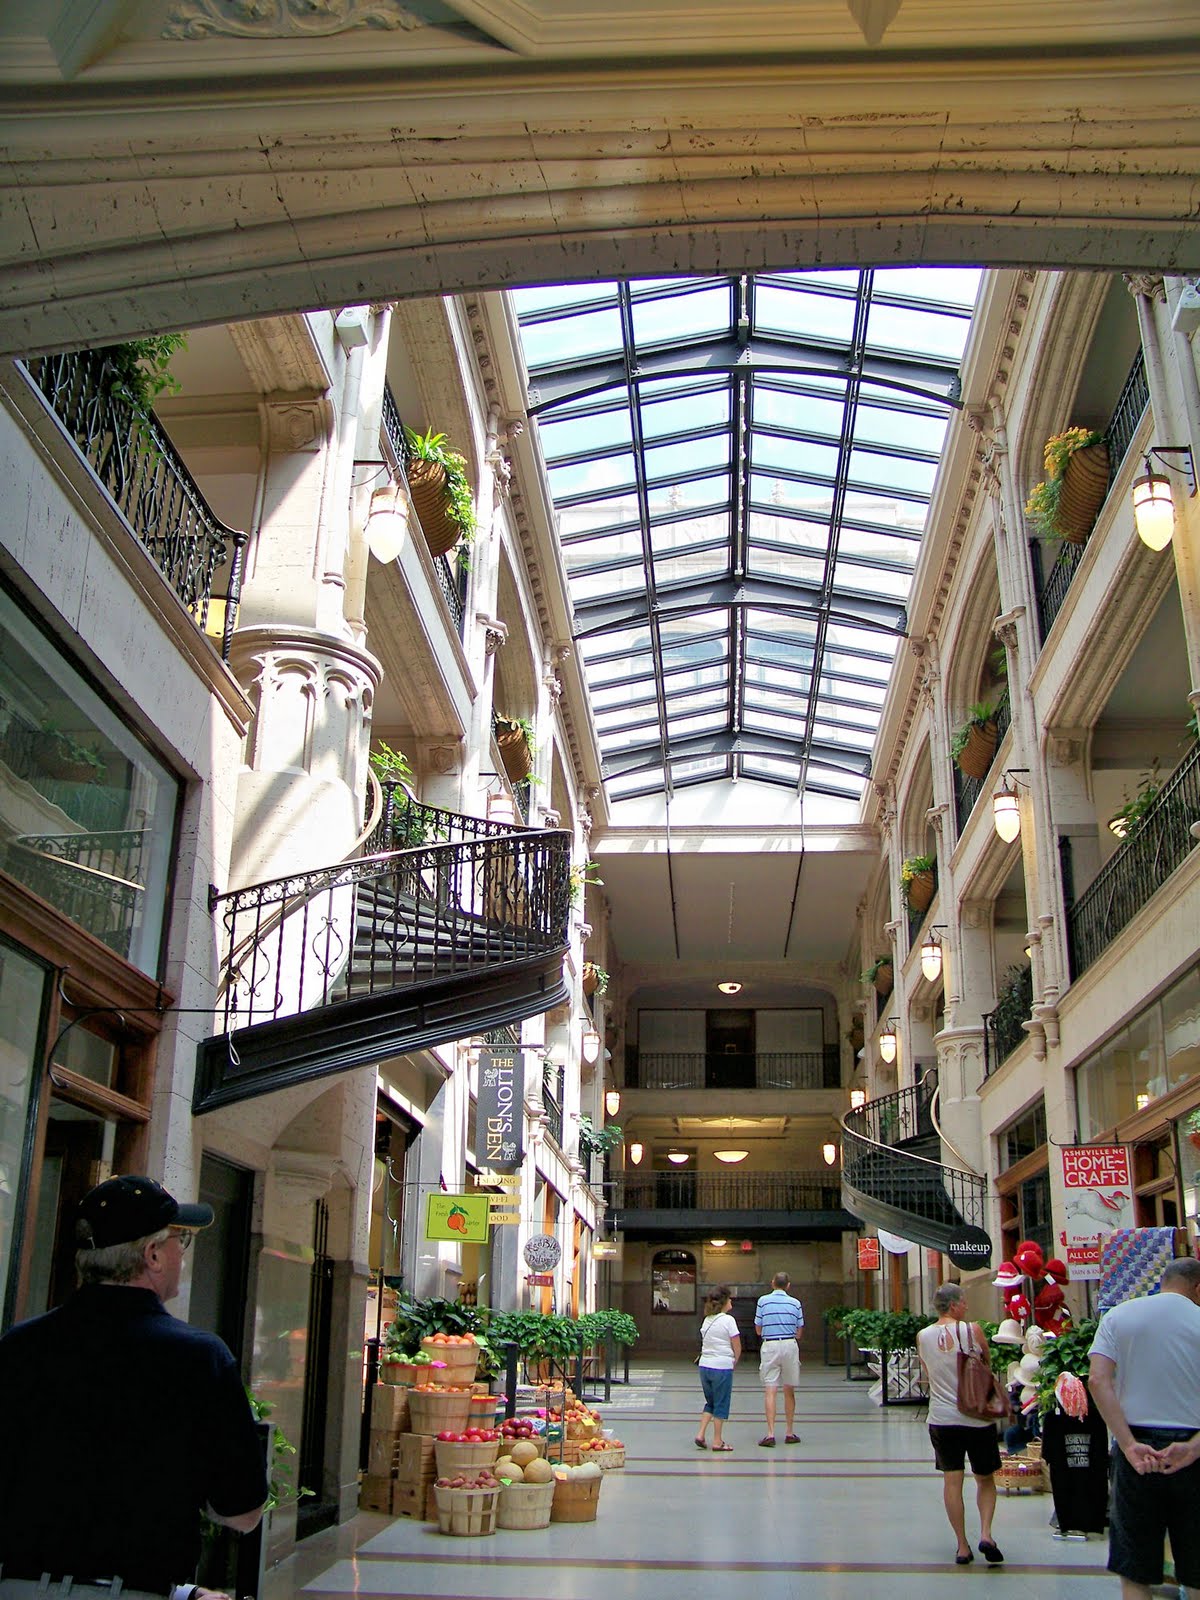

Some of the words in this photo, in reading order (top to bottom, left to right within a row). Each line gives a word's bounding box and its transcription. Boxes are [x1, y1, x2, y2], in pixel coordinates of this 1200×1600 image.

[491, 1058, 514, 1067] THE
[497, 1068, 514, 1133] LION'S
[486, 1117, 502, 1161] DEN
[1064, 1148, 1110, 1157] ASHEVILLE
[482, 1177, 516, 1185] SEATING
[1065, 1169, 1127, 1186] CRAFTS
[949, 1240, 991, 1255] makeup
[1083, 1251, 1099, 1259] LOC
